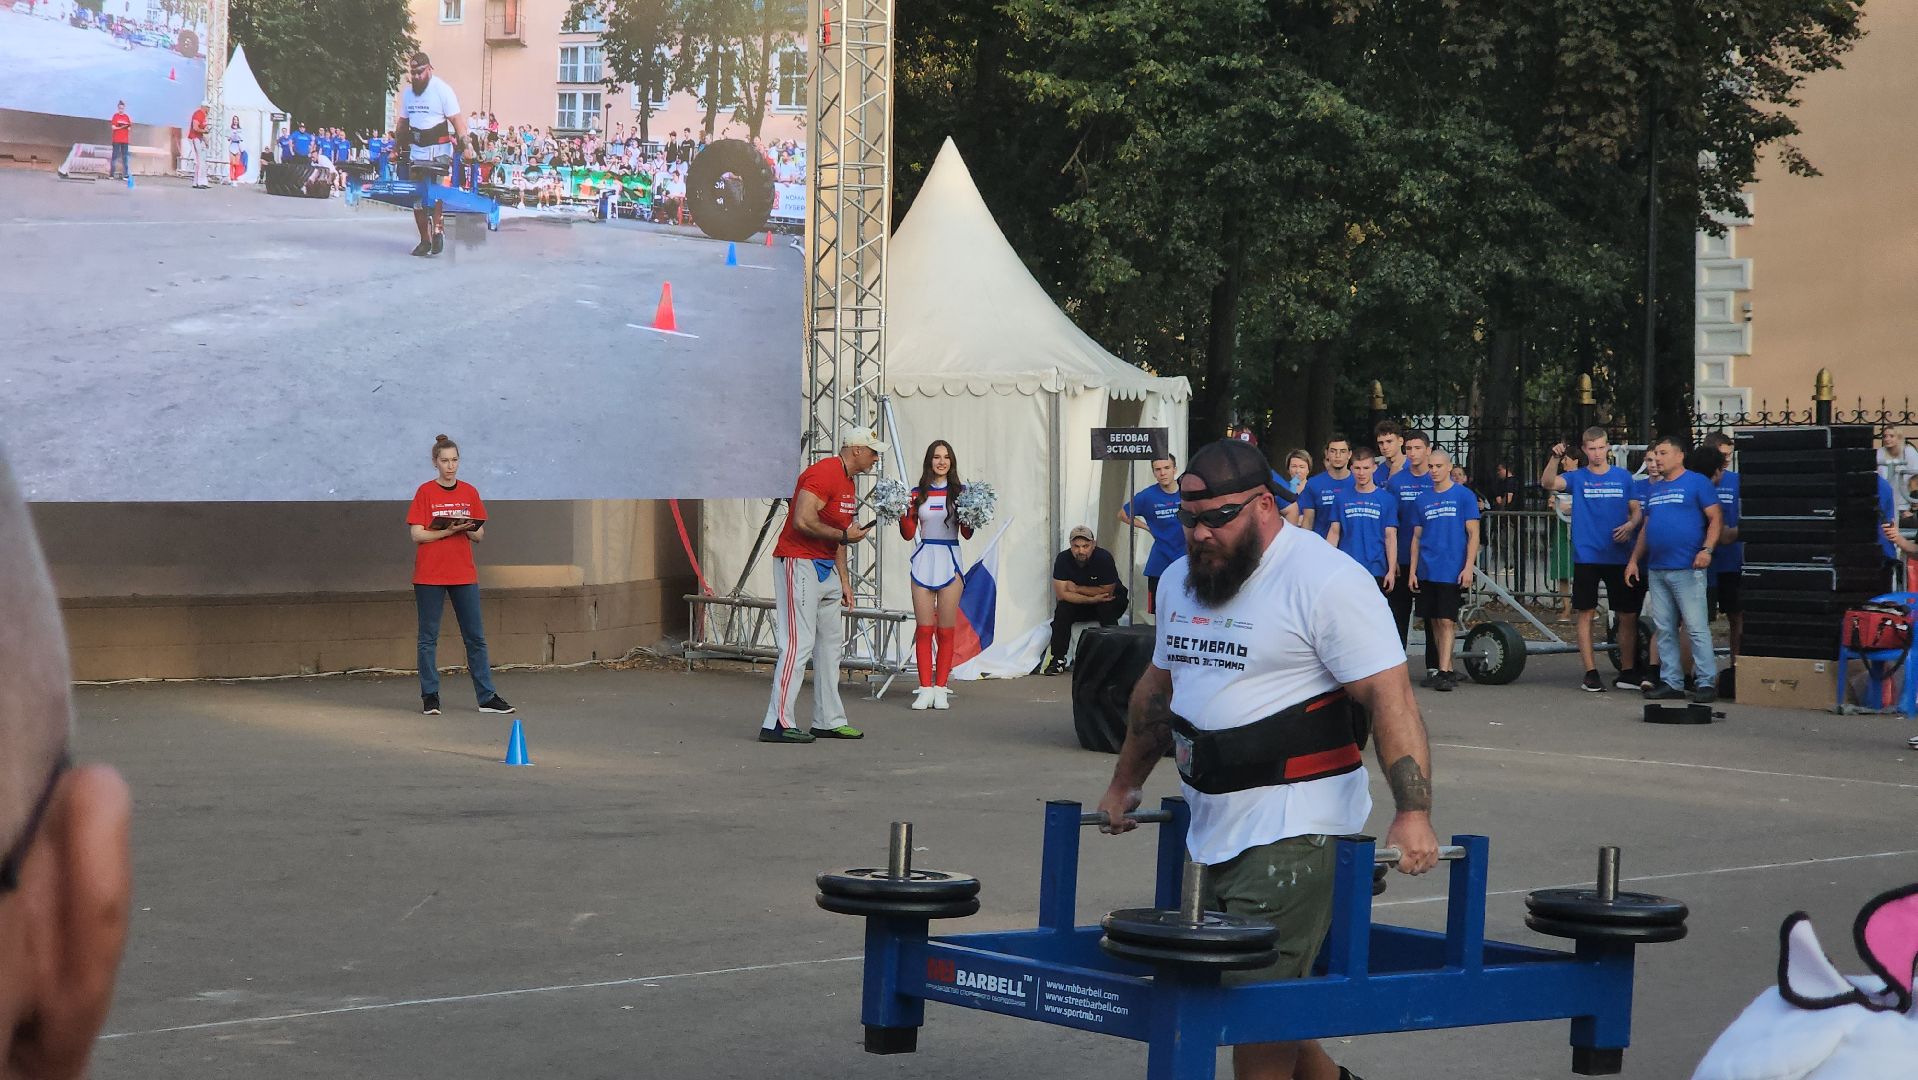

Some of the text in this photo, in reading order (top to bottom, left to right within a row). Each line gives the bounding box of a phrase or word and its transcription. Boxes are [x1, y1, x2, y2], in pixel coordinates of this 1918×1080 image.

[1110, 433, 1149, 442] БЕГОВАЯ
[1106, 445, 1152, 453] ЭСТАФЕТА
[956, 969, 1026, 998] BARBELL
[1046, 980, 1120, 1001] www.mbbarbell.com
[1044, 1004, 1104, 1023] www.sportmb.ru
[1045, 992, 1129, 1015] www.streetbarbell.com
